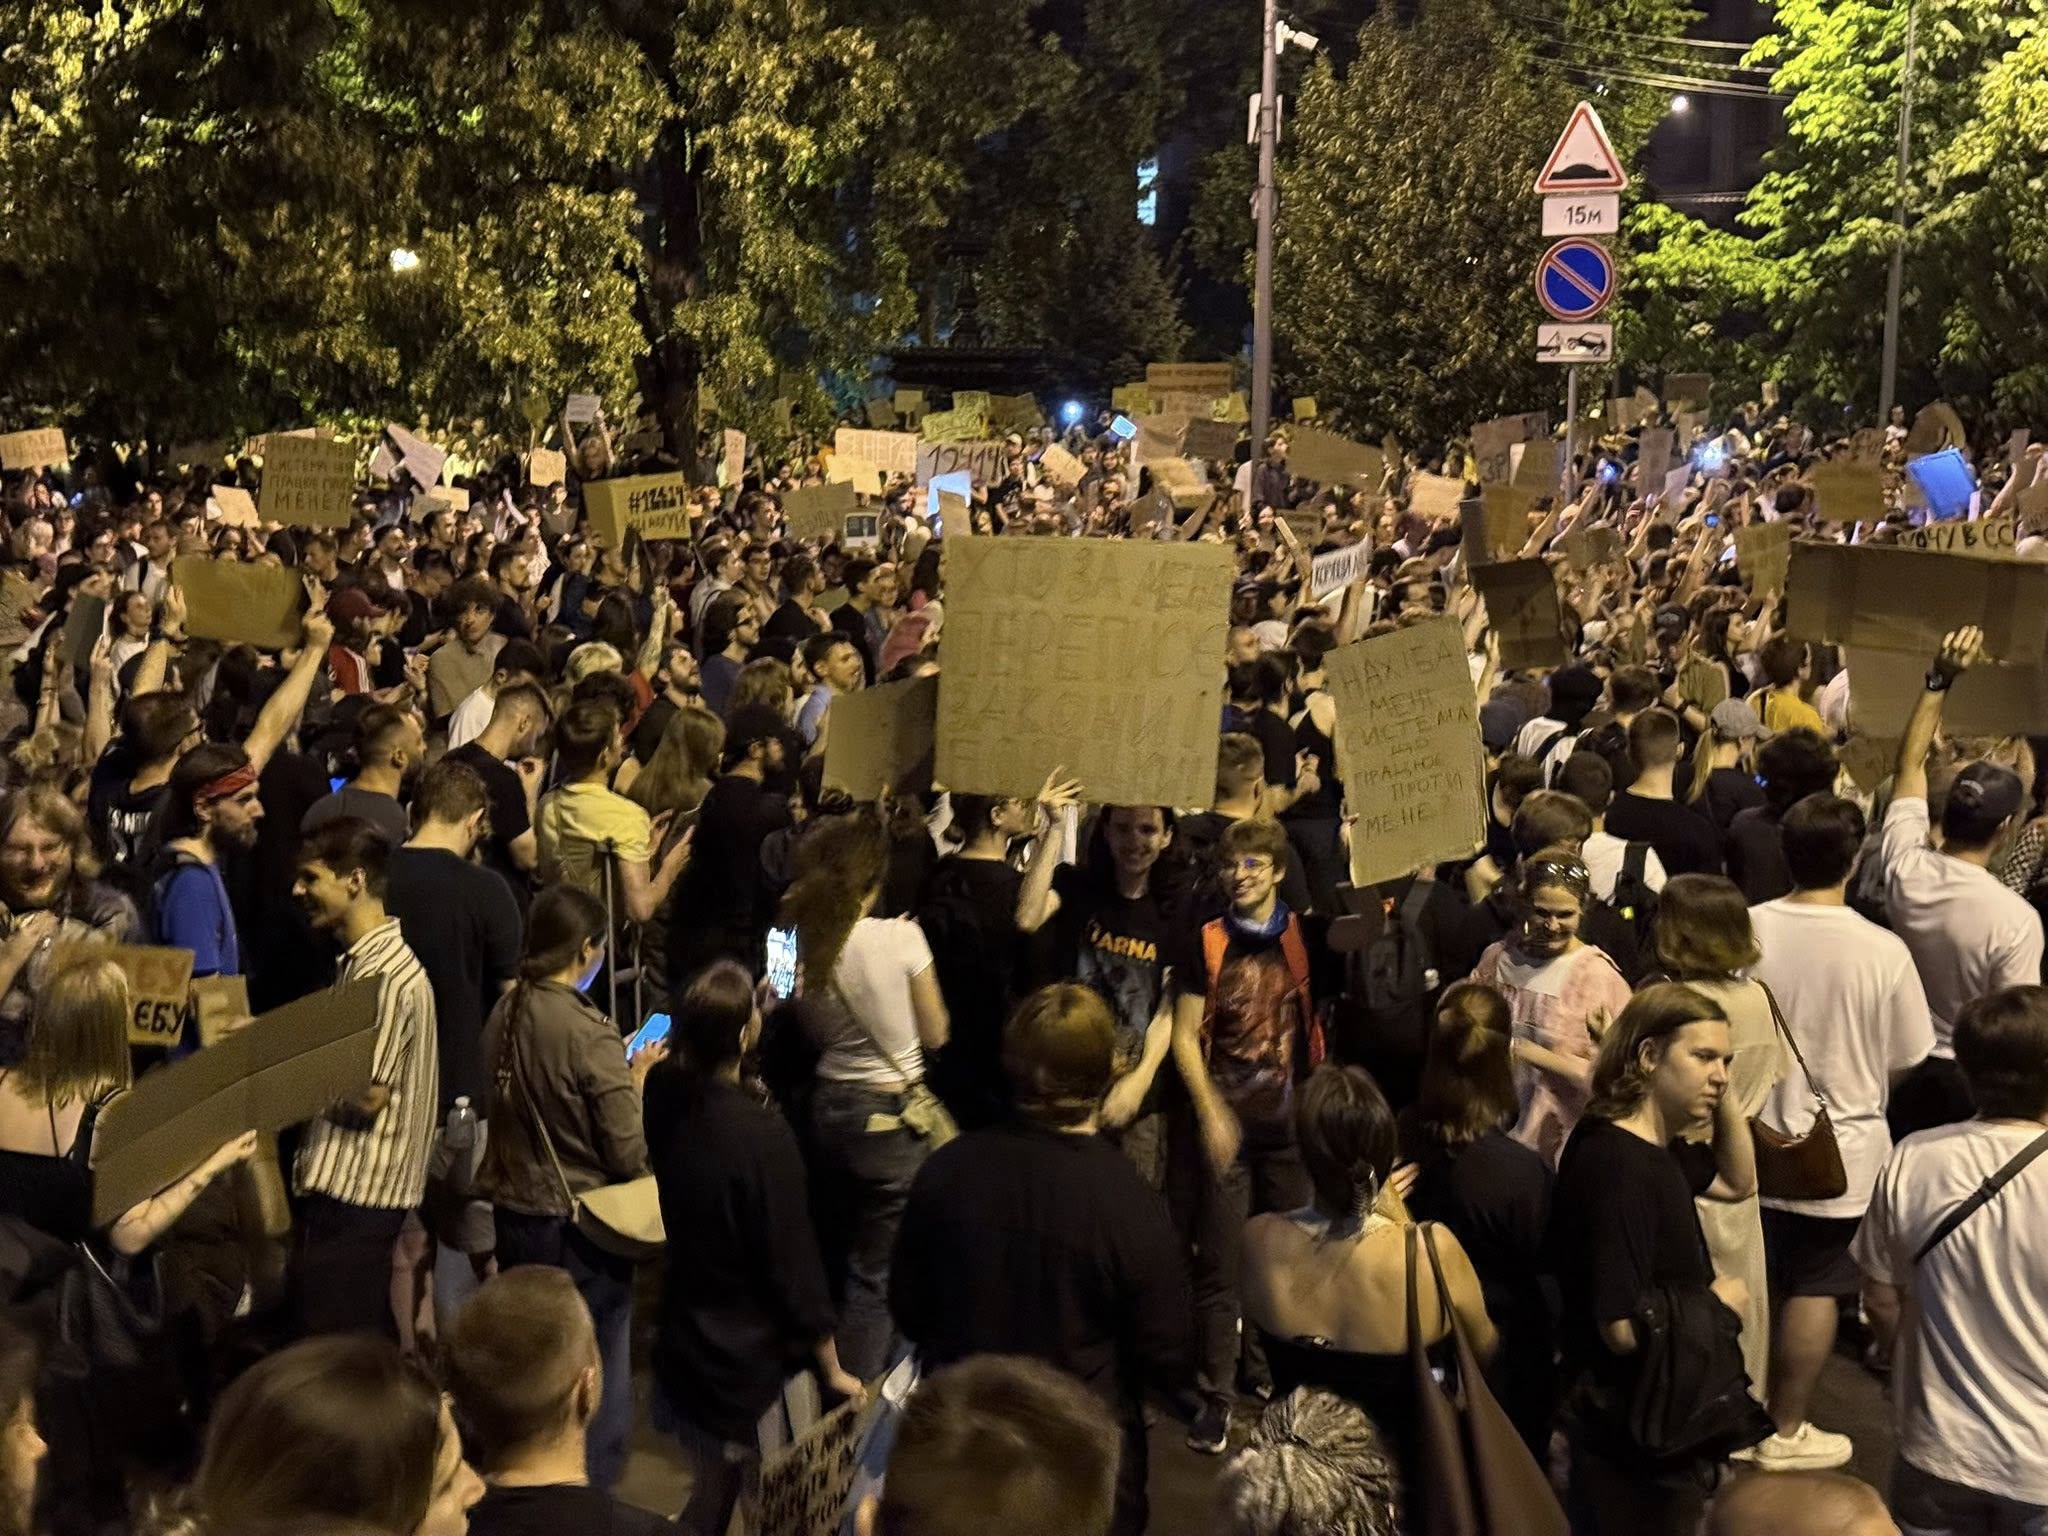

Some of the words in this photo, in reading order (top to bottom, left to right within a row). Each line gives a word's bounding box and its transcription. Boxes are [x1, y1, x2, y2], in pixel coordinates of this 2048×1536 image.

[956, 545, 1061, 602] ХТО
[1067, 546, 1123, 604] ЗА
[1339, 640, 1454, 700] НАХІБА
[1346, 705, 1470, 755] СИСТЕМА
[1391, 771, 1463, 802] ПРОТИ
